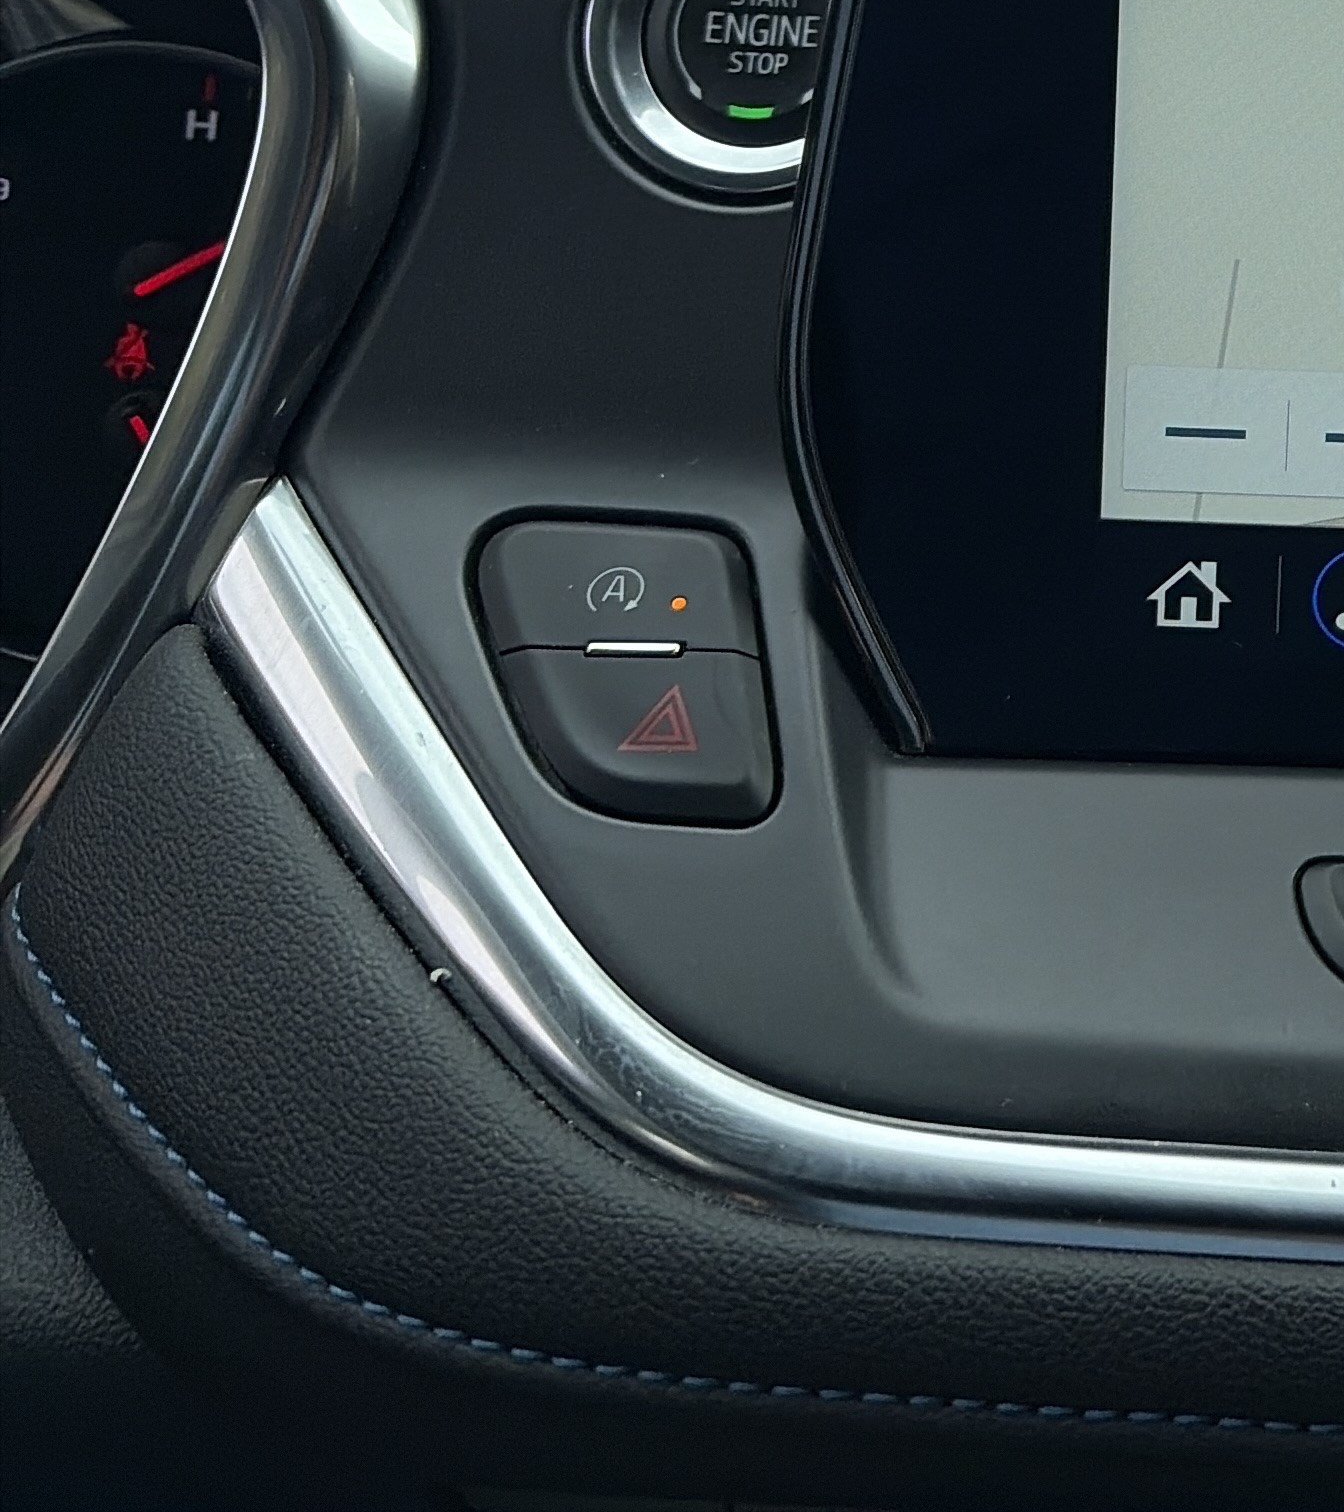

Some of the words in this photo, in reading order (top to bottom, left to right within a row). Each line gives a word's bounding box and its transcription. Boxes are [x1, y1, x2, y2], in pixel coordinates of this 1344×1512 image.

[704, 12, 820, 47] ENGINE
[727, 51, 789, 75] STOP
[186, 110, 218, 141] H
